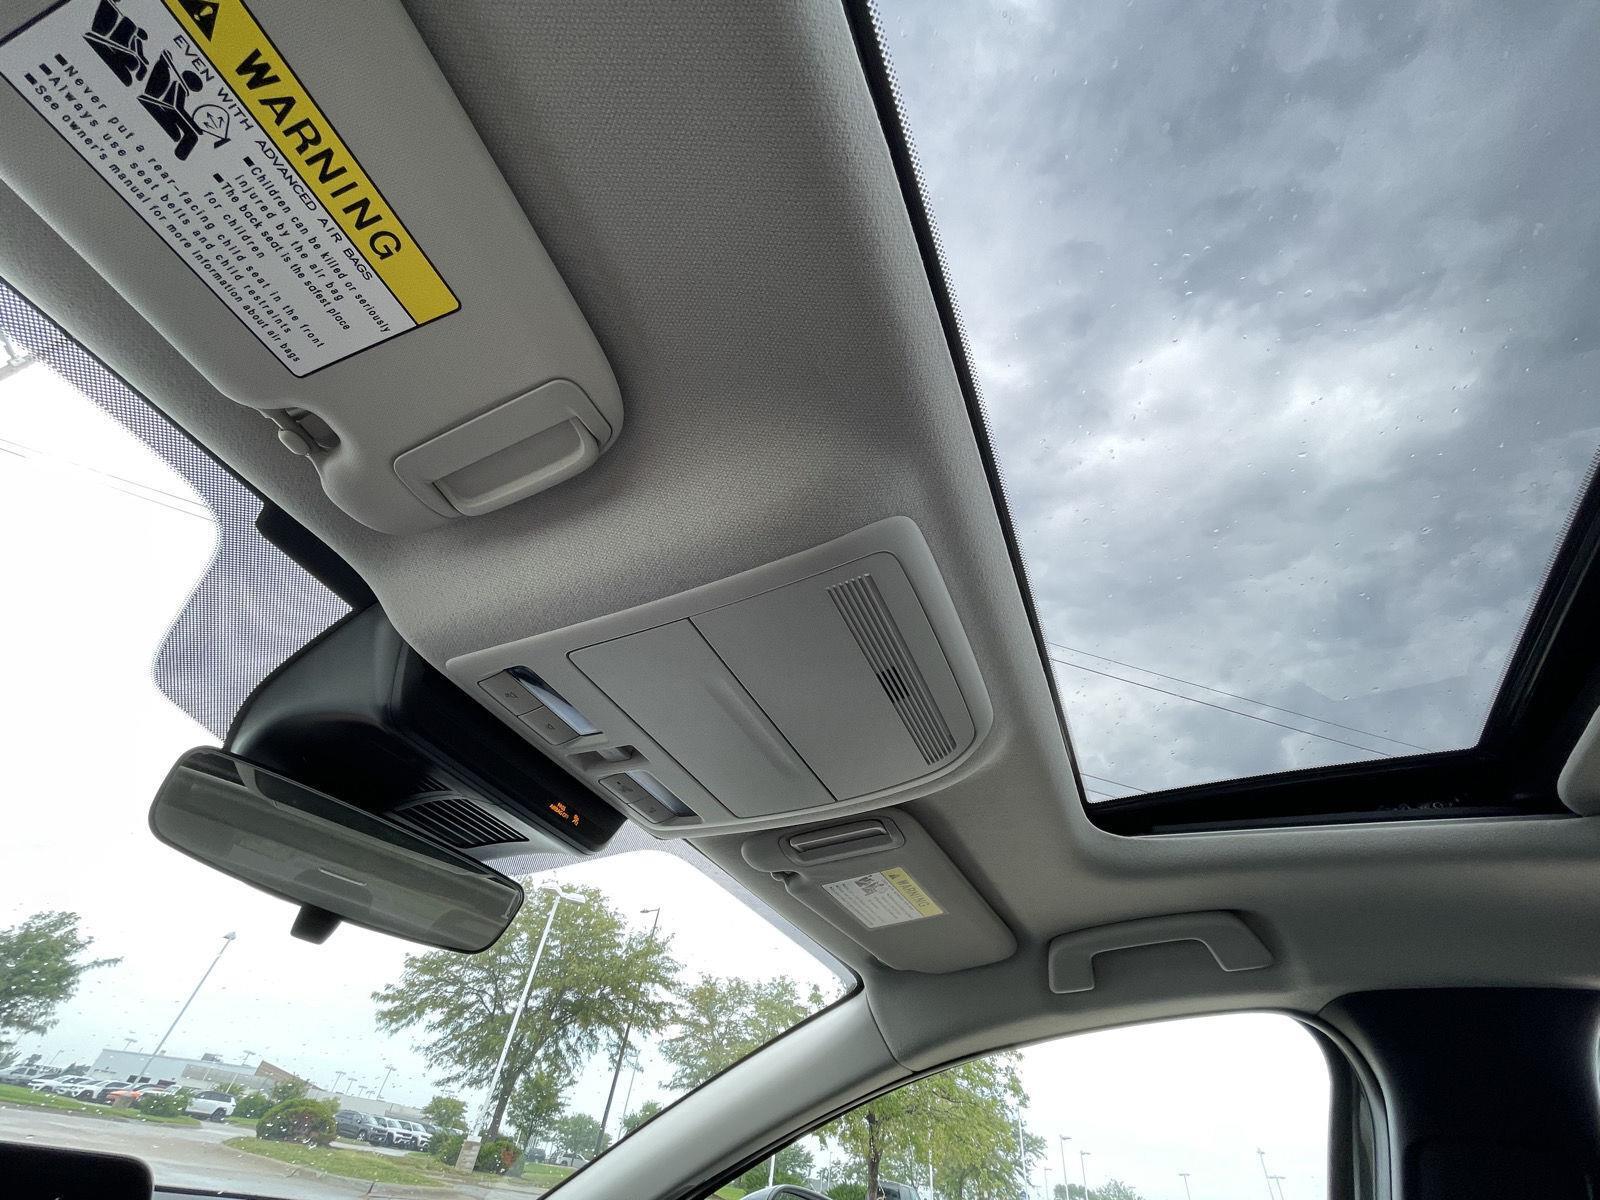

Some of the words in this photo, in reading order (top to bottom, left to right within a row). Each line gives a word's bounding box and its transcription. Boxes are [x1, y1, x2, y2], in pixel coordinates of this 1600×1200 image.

[35, 84, 59, 110] See
[62, 114, 108, 160] owner's
[109, 164, 151, 203] manual
[149, 205, 166, 221] for
[166, 224, 191, 249] more
[192, 250, 243, 303] information
[243, 304, 269, 329] about
[267, 330, 281, 342] air
[280, 342, 300, 363] bags
[49, 76, 98, 127] Always
[103, 133, 126, 156] use
[130, 162, 160, 190] seat
[160, 194, 190, 225] belts
[192, 230, 215, 250] and
[216, 254, 244, 281] child
[244, 284, 291, 333] restraints
[64, 65, 107, 110] Never
[108, 116, 135, 139] put
[148, 158, 215, 230] rear-facing
[217, 234, 246, 262] child
[246, 265, 270, 288] seat
[270, 291, 281, 302] in
[282, 304, 299, 321] the
[300, 324, 325, 348] front
[173, 34, 214, 82] EVEN
[217, 87, 254, 131] WITH
[254, 140, 317, 211] ADVANCED
[317, 218, 343, 243] AIR
[343, 247, 373, 281] BAGS
[204, 191, 222, 209] for
[223, 214, 265, 259] children
[235, 48, 402, 260] WARNING
[221, 182, 239, 203] The
[239, 204, 262, 229] back
[261, 230, 284, 252] seat
[281, 252, 291, 263] is
[290, 263, 305, 279] the
[304, 280, 332, 308] safest
[326, 308, 350, 330] place
[251, 167, 291, 213] Children
[291, 216, 309, 235] can
[308, 236, 321, 250] be
[320, 251, 348, 279] killed
[345, 281, 357, 291] or
[355, 293, 391, 332] seriously
[275, 223, 290, 237] by
[291, 240, 308, 259] the
[309, 264, 326, 278] air
[325, 281, 344, 301] bag
[898, 880, 930, 908] WARNING
